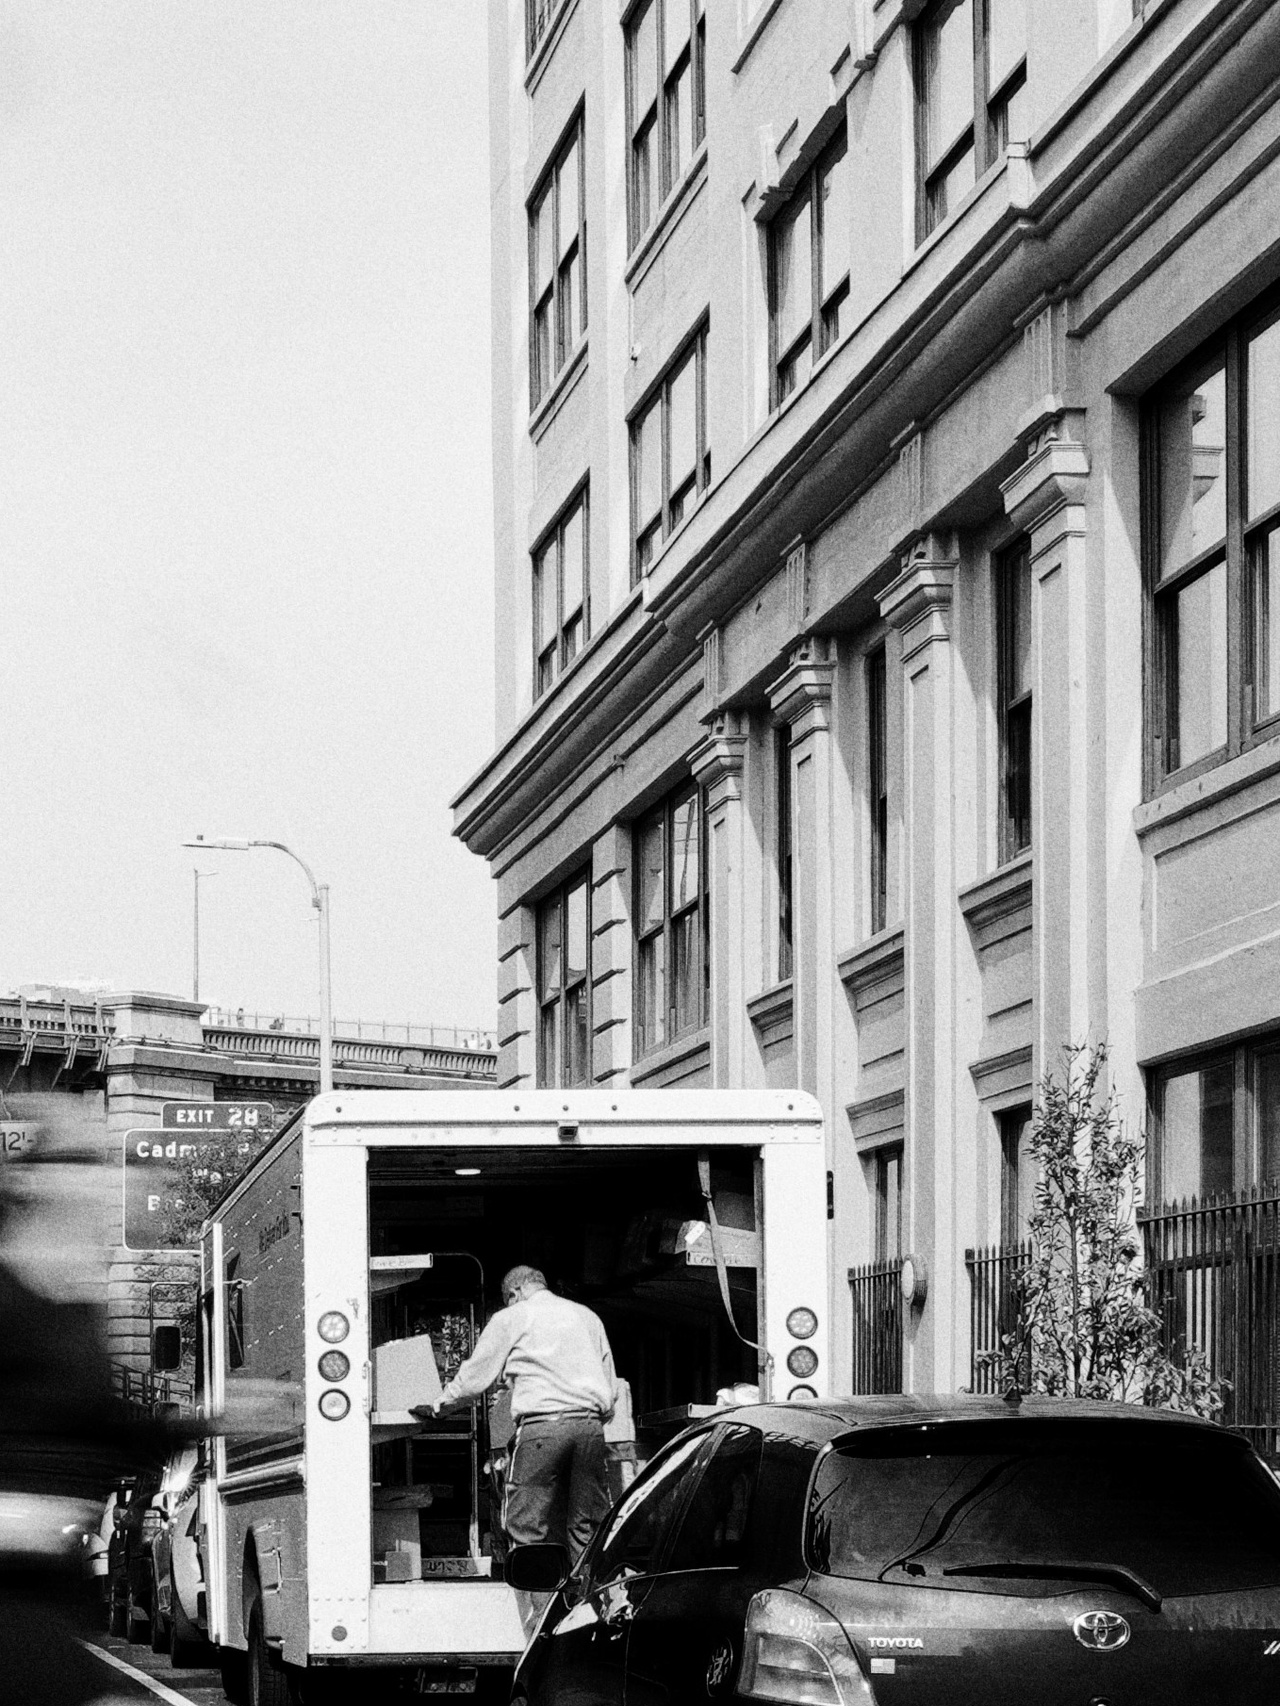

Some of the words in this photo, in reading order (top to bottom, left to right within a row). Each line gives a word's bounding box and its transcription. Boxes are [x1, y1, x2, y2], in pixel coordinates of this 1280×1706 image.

[176, 1109, 215, 1123] EXIT
[227, 1106, 259, 1126] 28
[867, 1637, 924, 1649] TOYOTA
